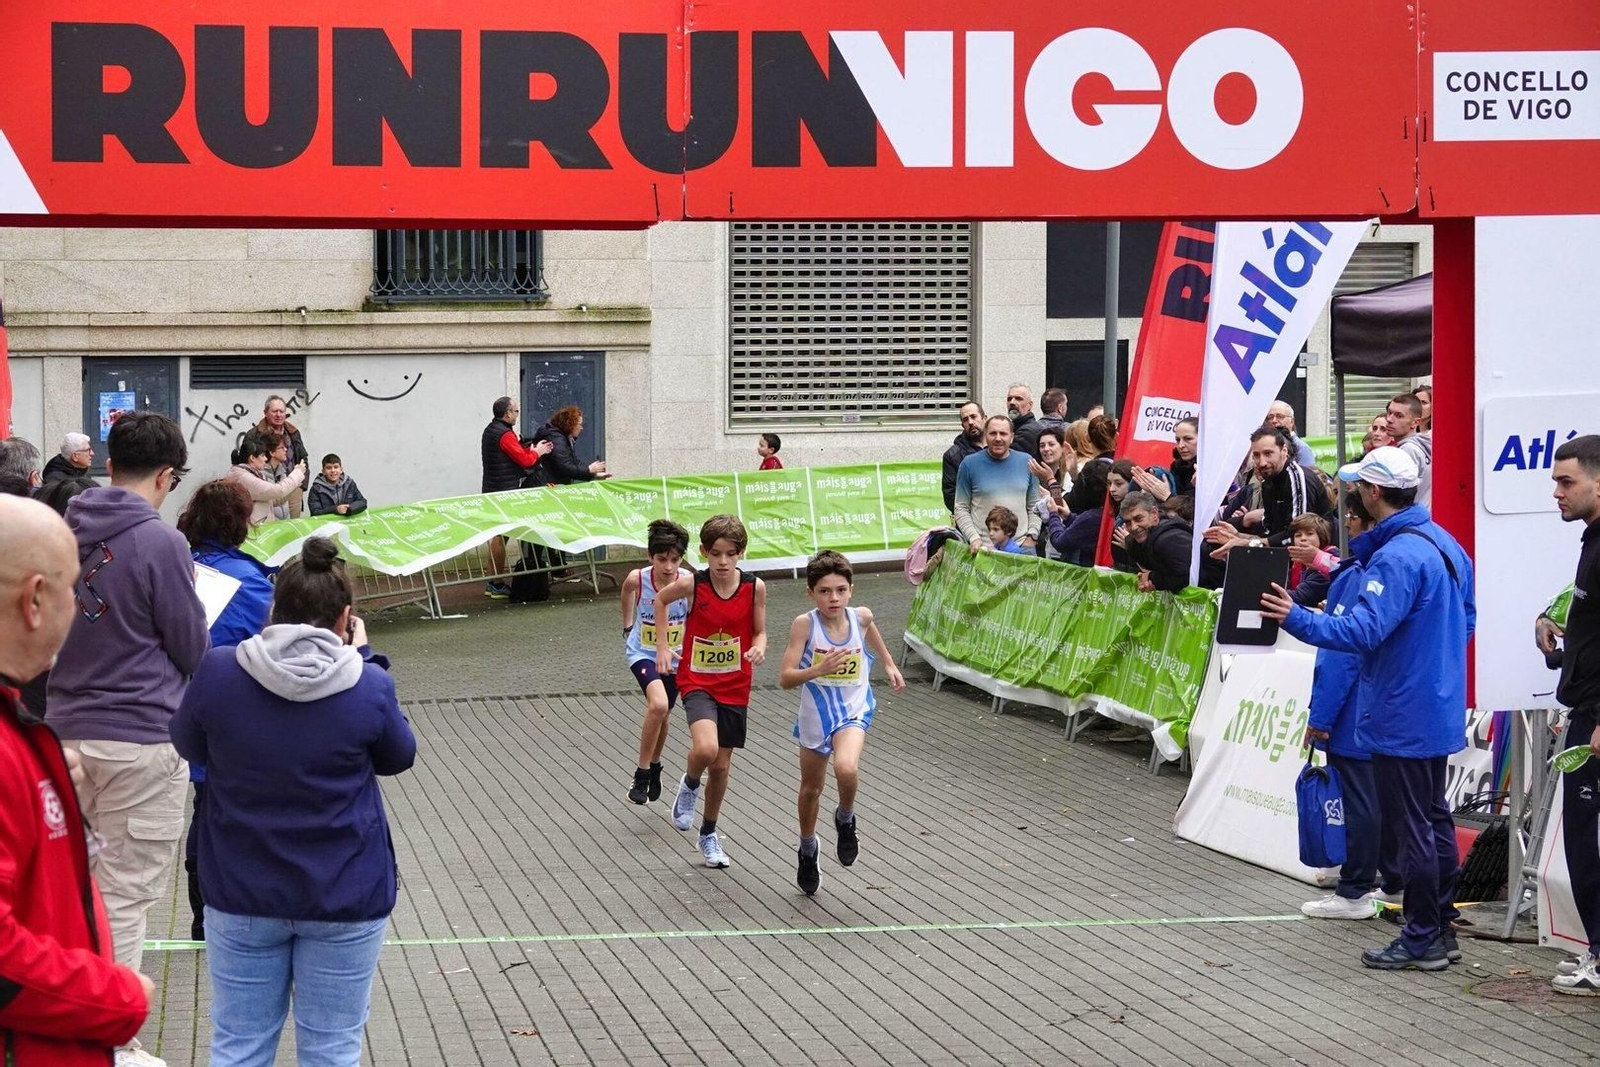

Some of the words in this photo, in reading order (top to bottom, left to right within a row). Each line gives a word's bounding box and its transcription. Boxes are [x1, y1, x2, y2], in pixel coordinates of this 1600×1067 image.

[1446, 70, 1588, 92] CONCELLO
[1464, 100, 1497, 120] DE
[1508, 99, 1571, 120] VIGO
[1371, 223, 1380, 237] 7
[1493, 430, 1577, 472] Atl
[745, 481, 769, 494] máis
[779, 481, 802, 493] auga
[817, 476, 840, 489] máis
[849, 476, 872, 489] auga
[673, 486, 698, 499] máis
[706, 486, 730, 498] auga
[749, 518, 773, 530] máis
[820, 512, 843, 525] máis
[852, 512, 876, 525] auga
[685, 523, 700, 534] áis
[699, 650, 734, 664] 1208
